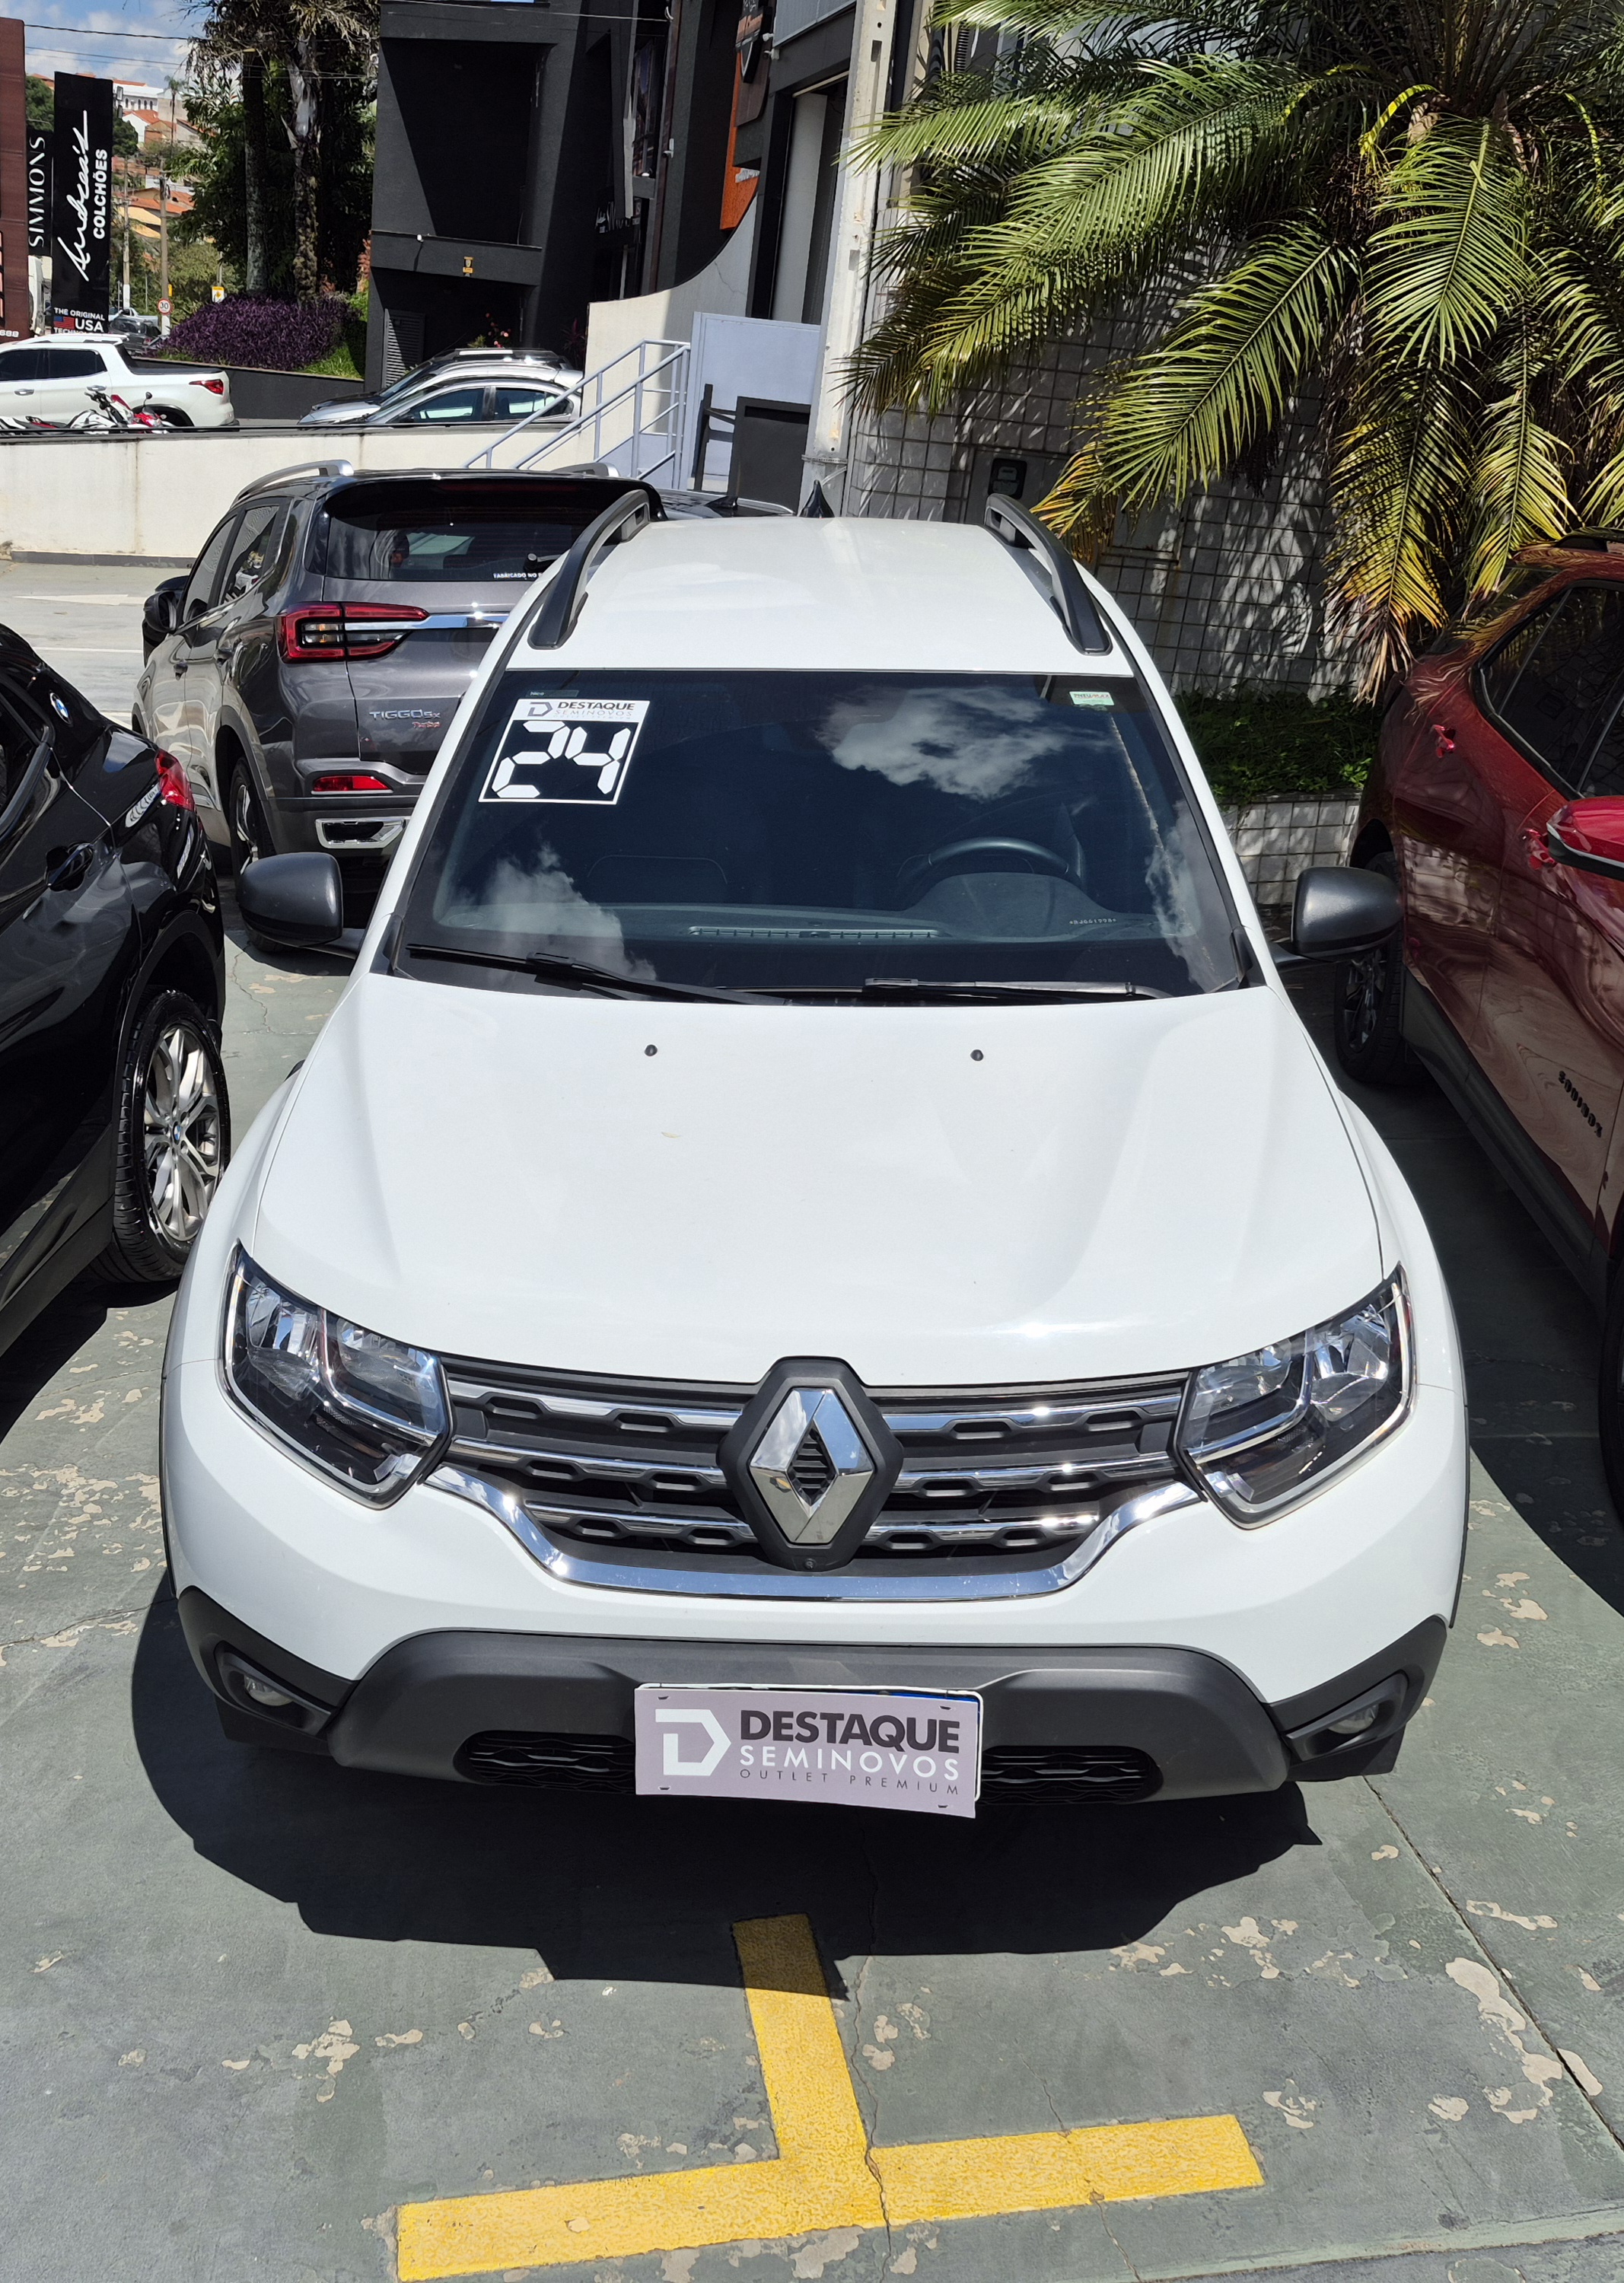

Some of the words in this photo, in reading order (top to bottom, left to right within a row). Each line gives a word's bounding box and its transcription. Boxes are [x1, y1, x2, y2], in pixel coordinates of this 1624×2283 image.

[29, 136, 46, 247] SIMMONS
[93, 148, 107, 239] COLCHÕES
[70, 310, 105, 321] ORIGINAL
[75, 318, 104, 333] USA
[557, 702, 636, 711] DESTAQUE
[491, 720, 632, 798] 24
[740, 1709, 960, 1754] DESTAQUE
[739, 1744, 959, 1782] SEMINOVOS
[740, 1769, 828, 1783] OUTLET
[849, 1775, 959, 1795] PREMIUM
